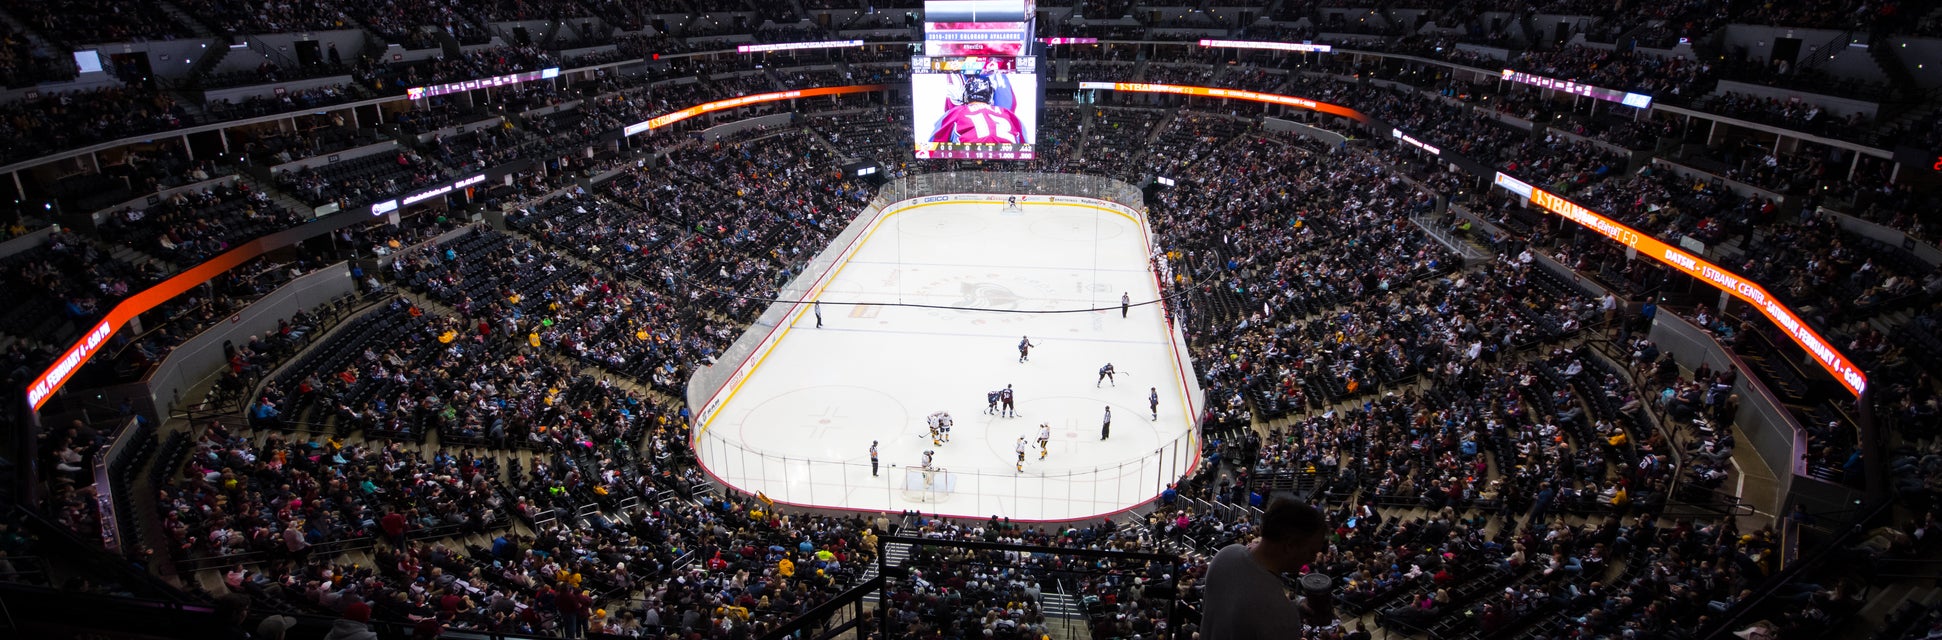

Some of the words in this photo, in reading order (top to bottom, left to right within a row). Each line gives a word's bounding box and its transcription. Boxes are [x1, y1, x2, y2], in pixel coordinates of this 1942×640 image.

[934, 61, 940, 70] 0
[1006, 61, 1011, 70] 1
[924, 195, 949, 203] GEICO
[1665, 249, 1697, 271] DATSIK
[1702, 265, 1738, 291] 1STBANK
[1738, 282, 1765, 306] CENTER
[1766, 300, 1800, 338] SATURDAY,
[1798, 327, 1836, 366] FEBRUARY
[1833, 358, 1841, 372] 4
[46, 348, 81, 390] FEBRUARY
[79, 344, 86, 357] 4
[99, 321, 111, 340] PM
